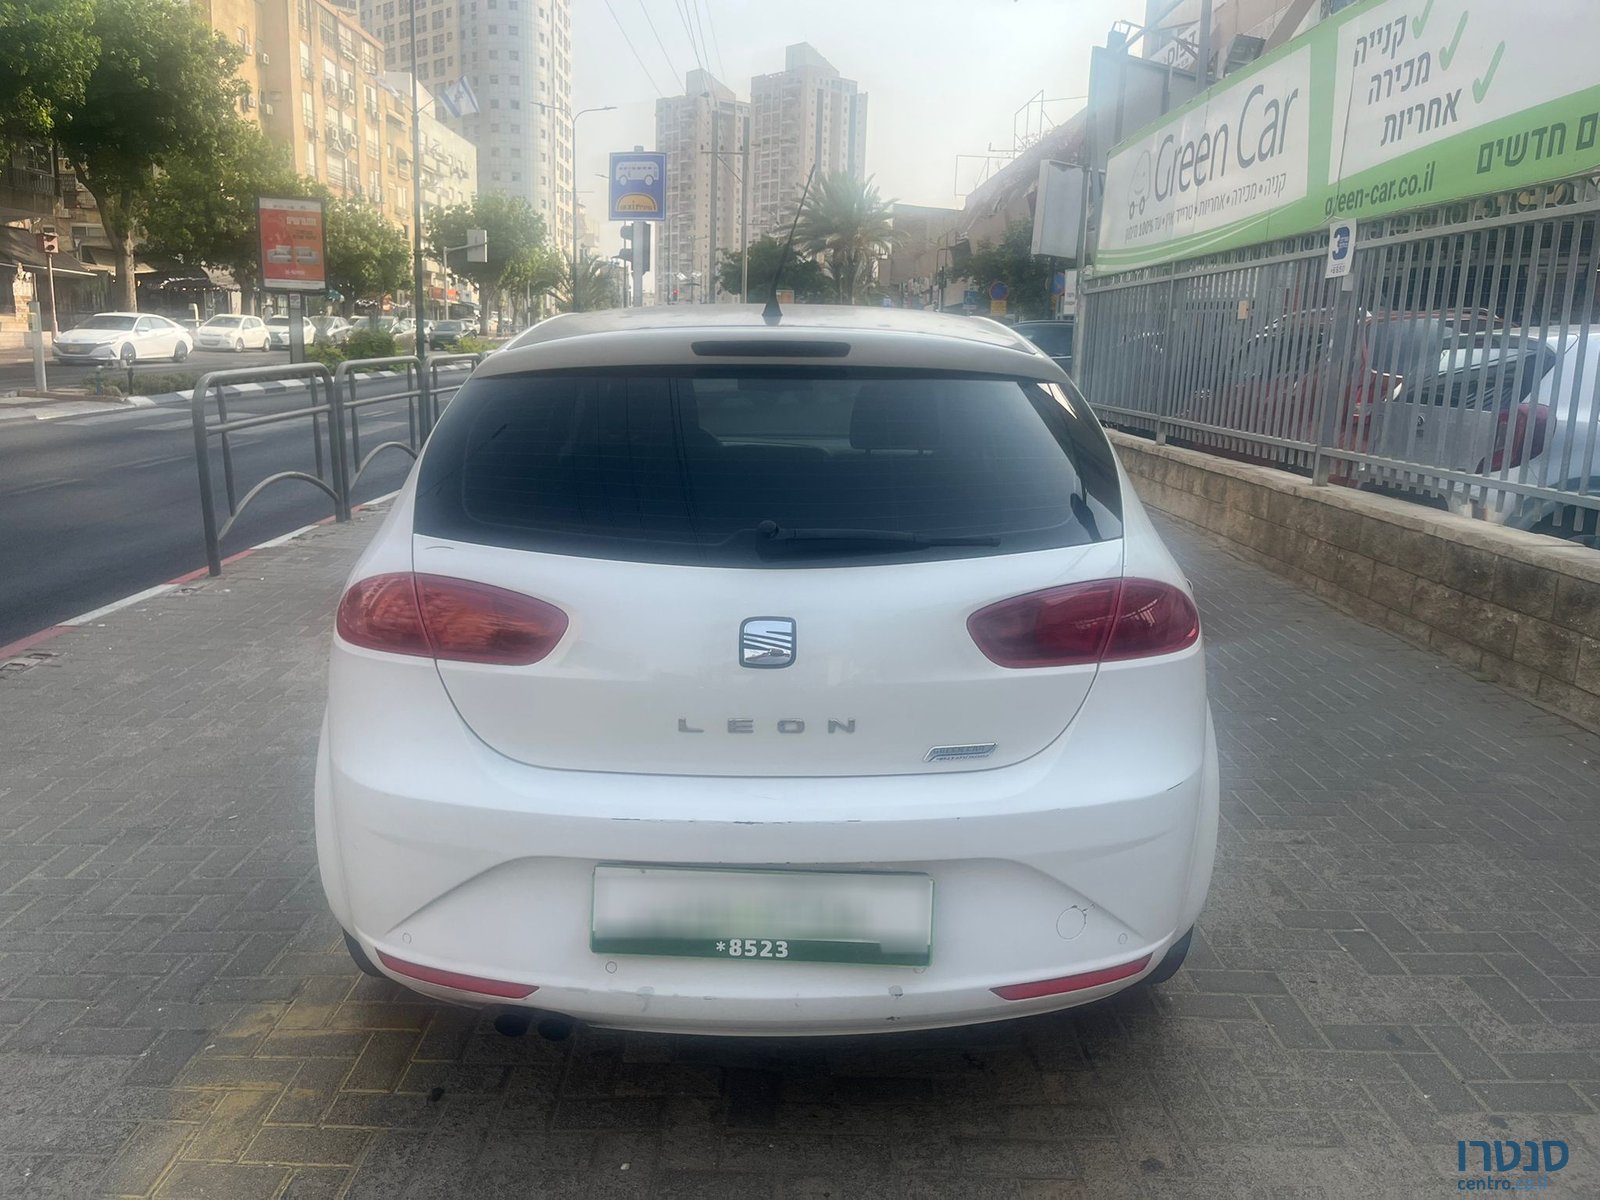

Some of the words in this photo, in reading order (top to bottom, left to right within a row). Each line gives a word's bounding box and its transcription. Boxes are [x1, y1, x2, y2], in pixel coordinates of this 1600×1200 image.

[1353, 15, 1407, 67] קנייה
[1368, 51, 1431, 105] מכירה
[1155, 124, 1228, 202] Green
[1237, 84, 1299, 168] Car
[1380, 88, 1462, 147] אחריות
[1477, 122, 1567, 174] חדשים
[1199, 193, 1226, 217] אחריות
[1231, 182, 1258, 207] מכירה
[1264, 172, 1287, 199] קניה
[678, 717, 857, 735] LEON
